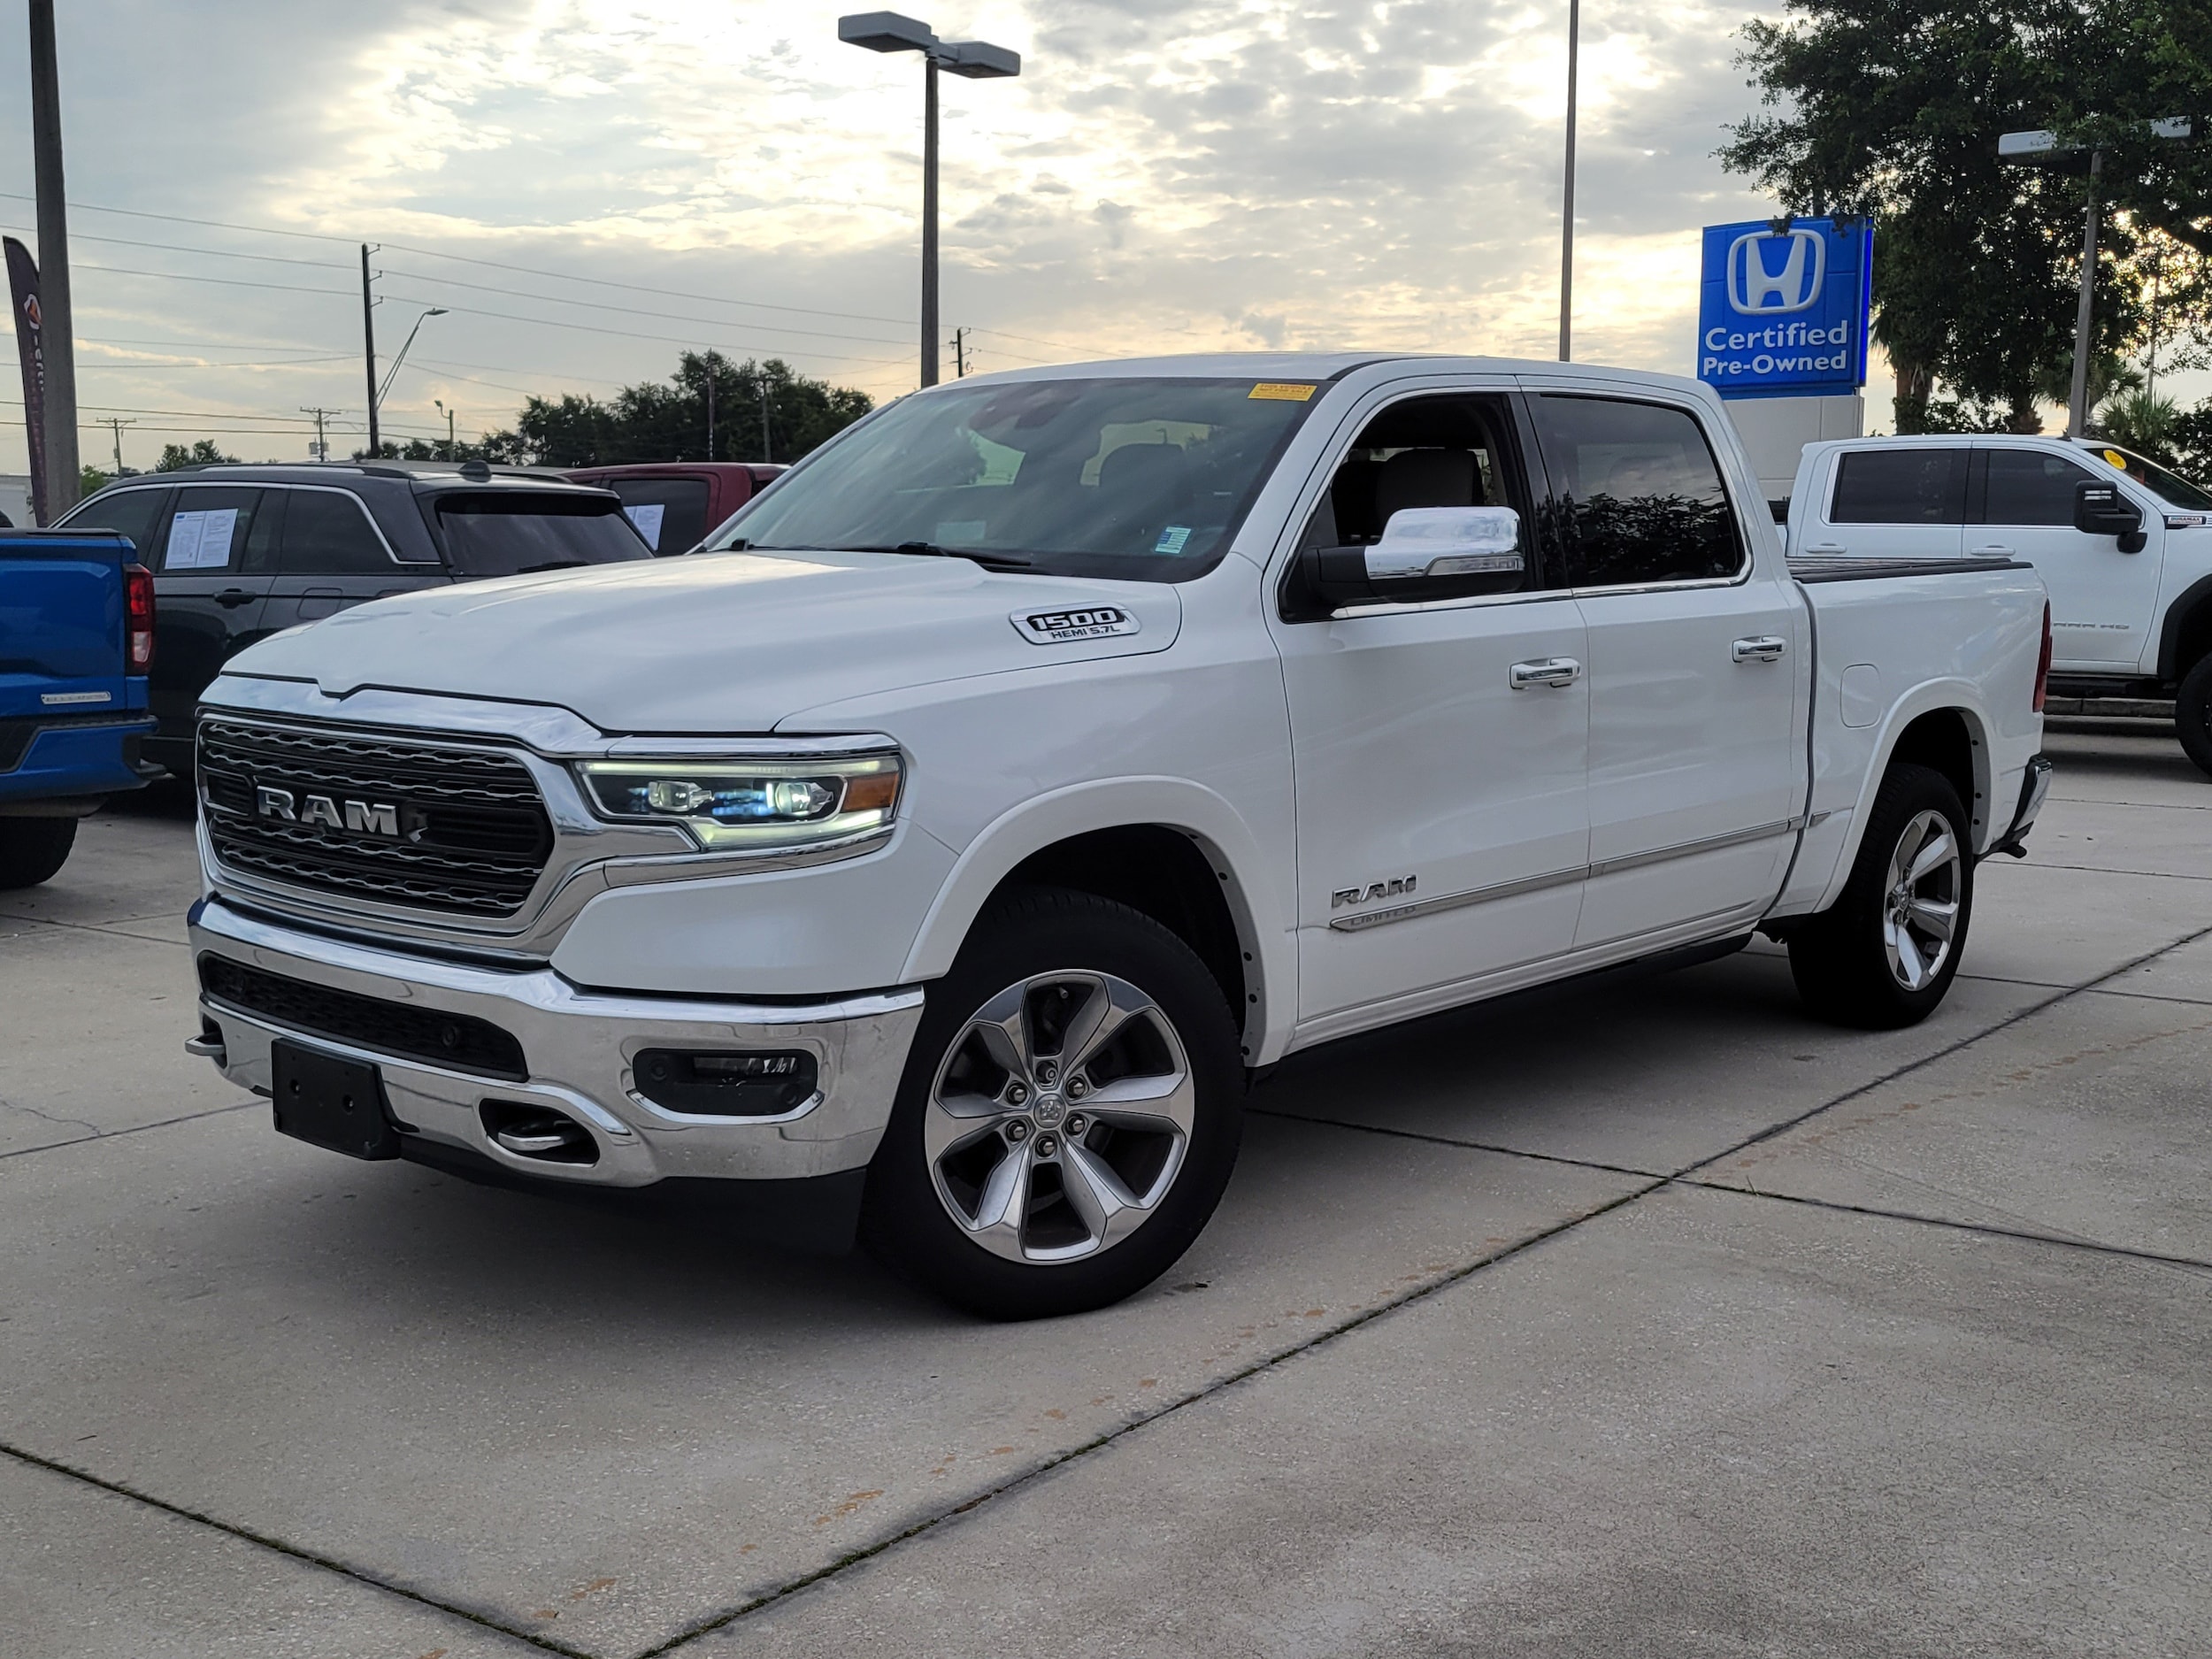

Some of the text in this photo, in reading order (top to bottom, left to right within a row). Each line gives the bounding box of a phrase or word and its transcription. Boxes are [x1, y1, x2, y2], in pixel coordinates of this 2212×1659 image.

[1705, 319, 1848, 351] Certified
[1703, 349, 1847, 376] Pre-Owned
[1031, 610, 1118, 631] 1500
[1050, 625, 1121, 640] HEMI 5.7L
[257, 785, 398, 836] RAM
[1331, 874, 1417, 909] RAM
[1350, 906, 1417, 926] LIMITED
